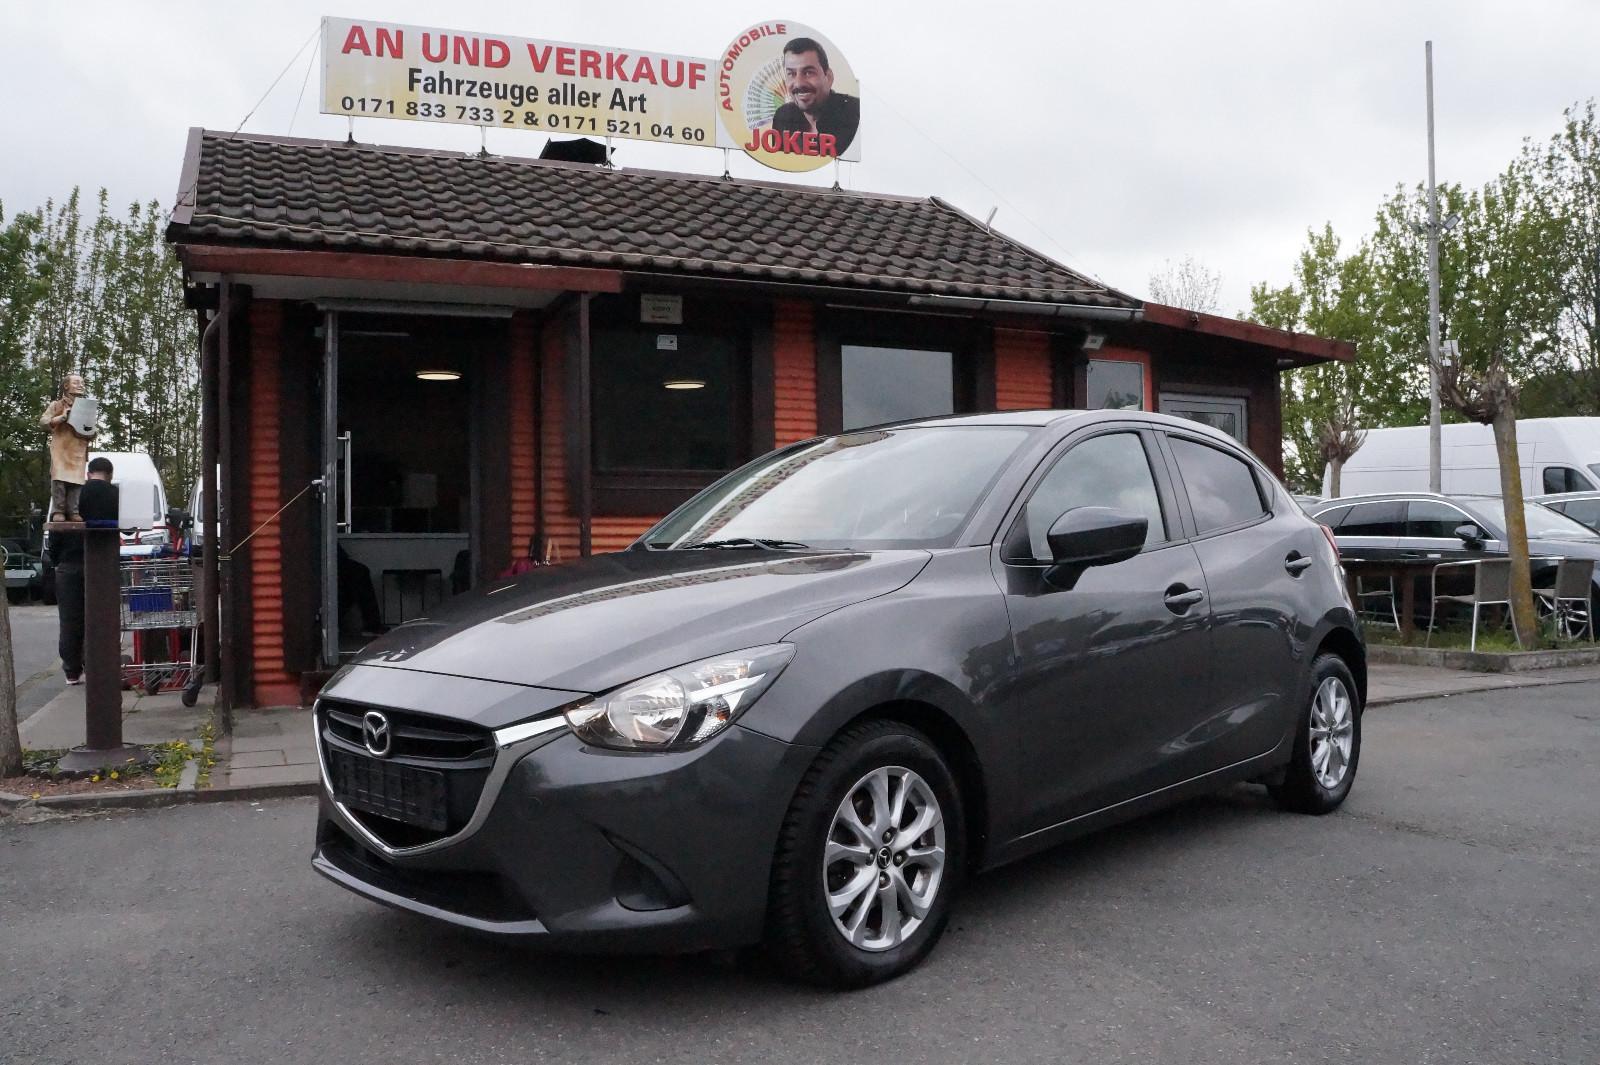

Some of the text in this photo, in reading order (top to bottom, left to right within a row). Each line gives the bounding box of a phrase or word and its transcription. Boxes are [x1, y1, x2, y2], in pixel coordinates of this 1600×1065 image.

[341, 25, 706, 90] AN UND VERKAUF
[720, 23, 787, 112] AUTOMOBILE
[408, 67, 647, 114] Fahrzeuge aller Art
[341, 96, 705, 142] 0171 833 733 2 & 0171 521 04 60
[744, 128, 838, 158] JOKER
